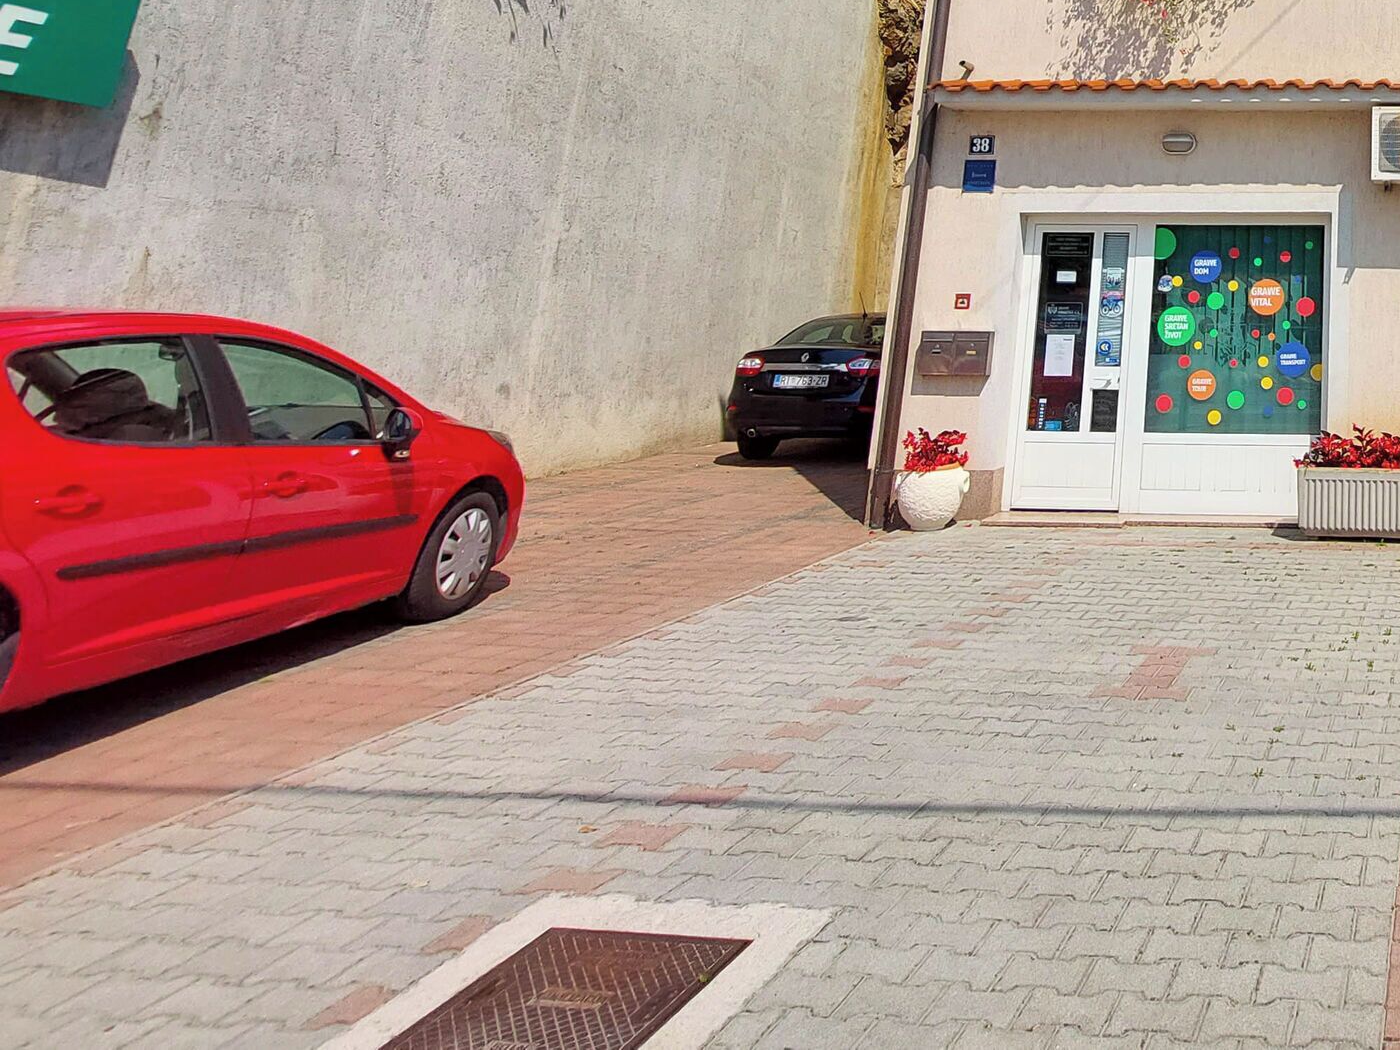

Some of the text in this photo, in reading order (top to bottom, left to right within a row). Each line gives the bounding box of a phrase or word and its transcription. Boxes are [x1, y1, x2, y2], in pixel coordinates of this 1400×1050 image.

[972, 137, 990, 152] 38
[1194, 259, 1217, 267] GRAWE
[1251, 287, 1281, 296] GRAWE
[1251, 298, 1272, 306] VITAL
[1164, 315, 1188, 323] GRAWE
[1164, 329, 1182, 339] ŽIVOT
